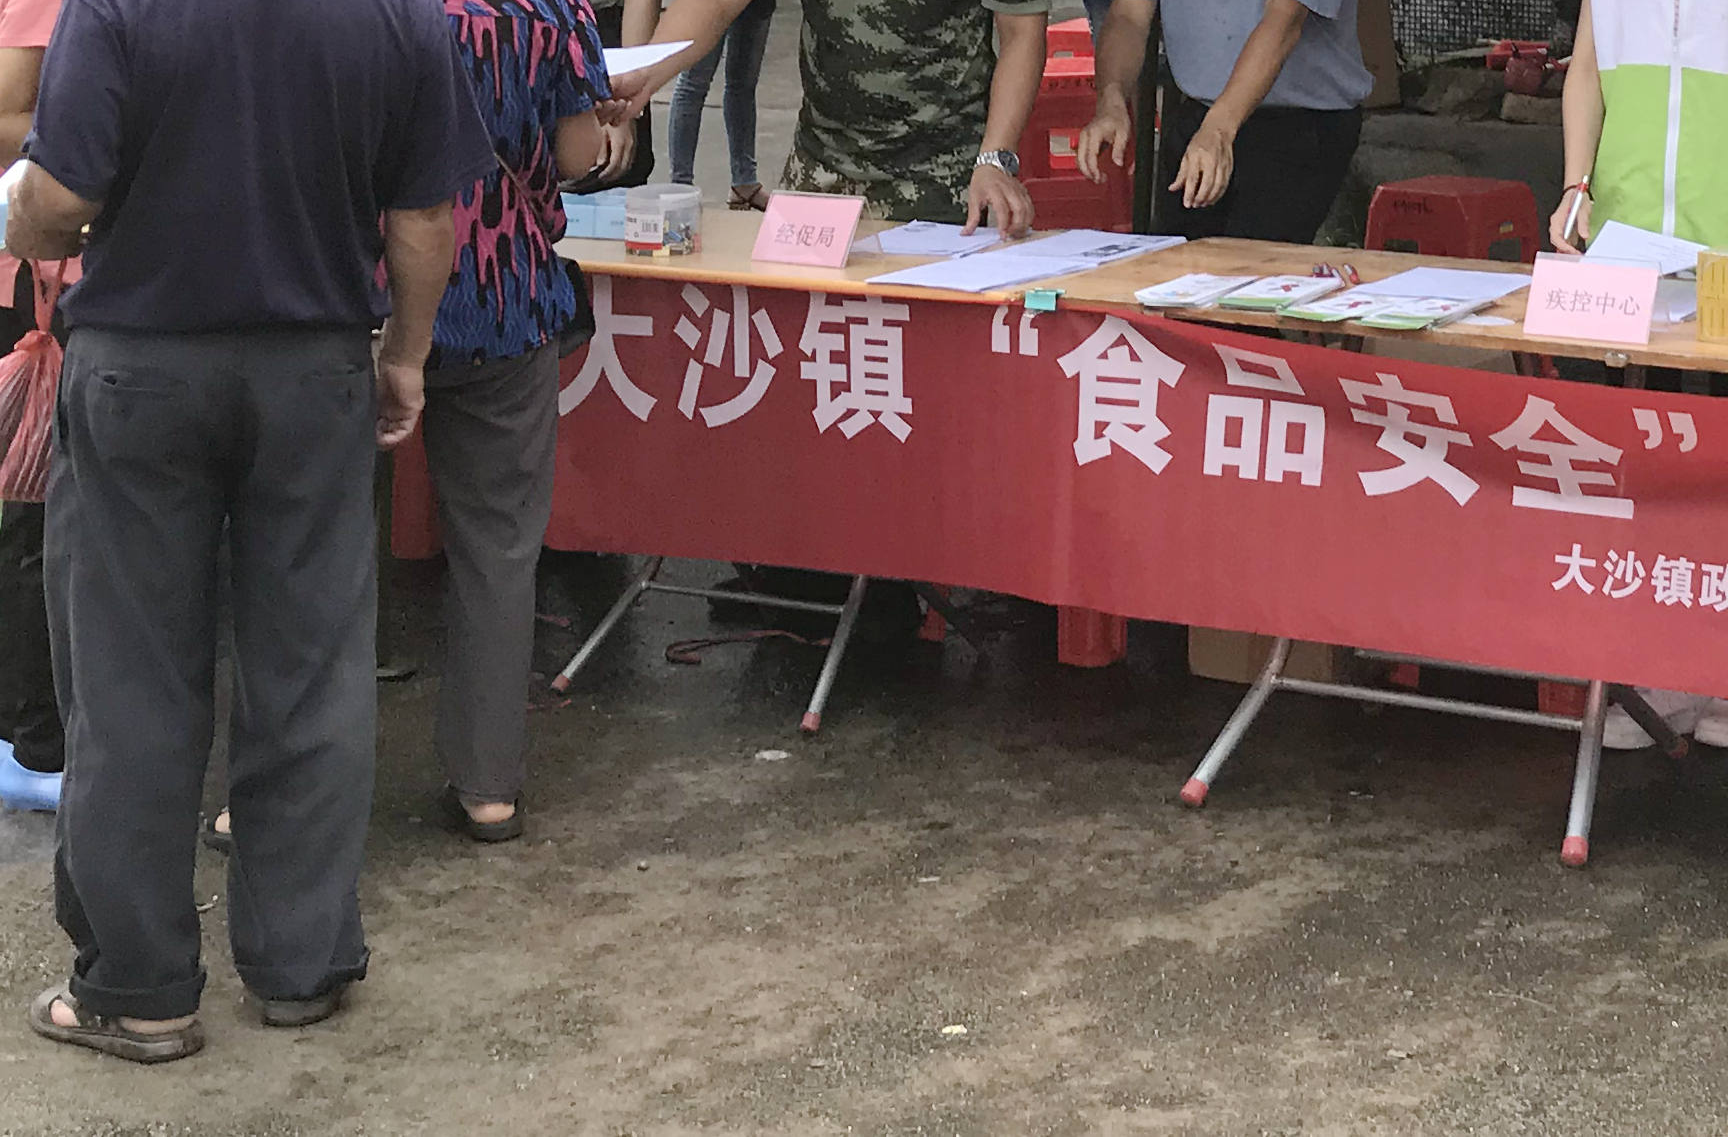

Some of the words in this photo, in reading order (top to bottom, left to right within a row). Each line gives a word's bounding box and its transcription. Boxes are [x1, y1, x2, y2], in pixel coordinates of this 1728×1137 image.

[774, 221, 838, 249] 经促局
[1544, 287, 1642, 320] 疾控中心
[558, 274, 914, 443] 大沙镇
